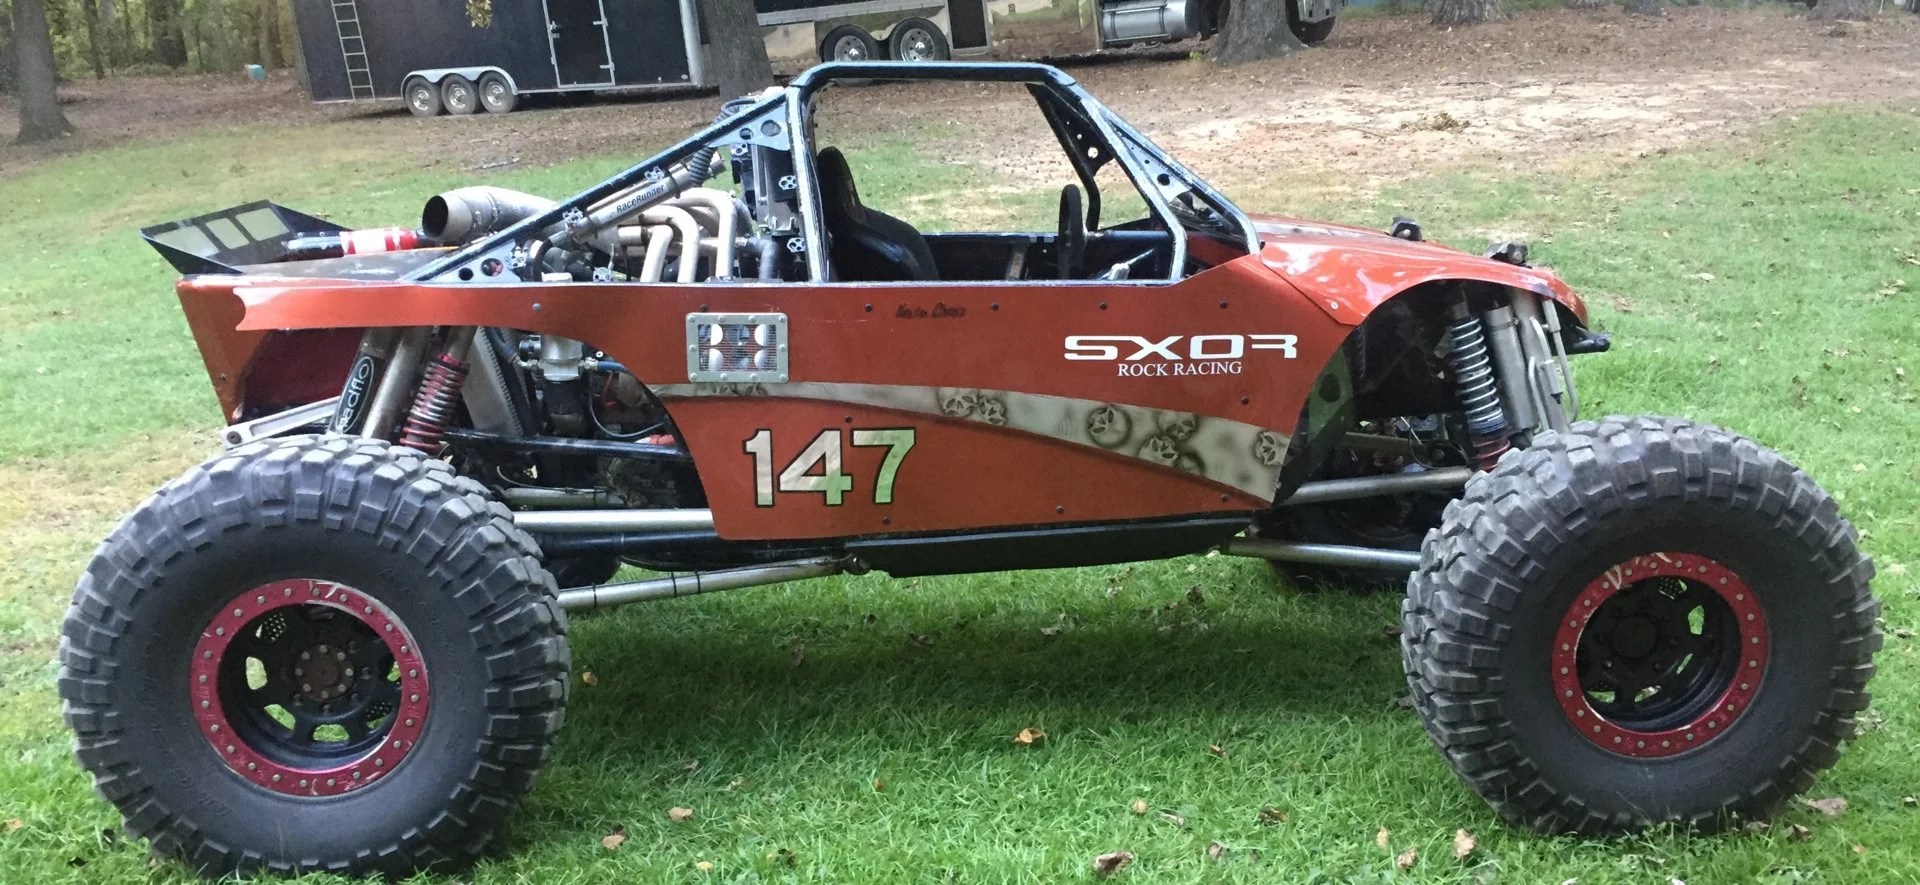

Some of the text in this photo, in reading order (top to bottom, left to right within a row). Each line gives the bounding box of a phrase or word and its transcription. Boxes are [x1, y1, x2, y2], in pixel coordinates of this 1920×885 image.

[616, 184, 665, 214] RaceRunner
[1064, 334, 1298, 361] SXOR
[1117, 361, 1243, 377] ROCK RACING
[742, 427, 917, 507] 147
